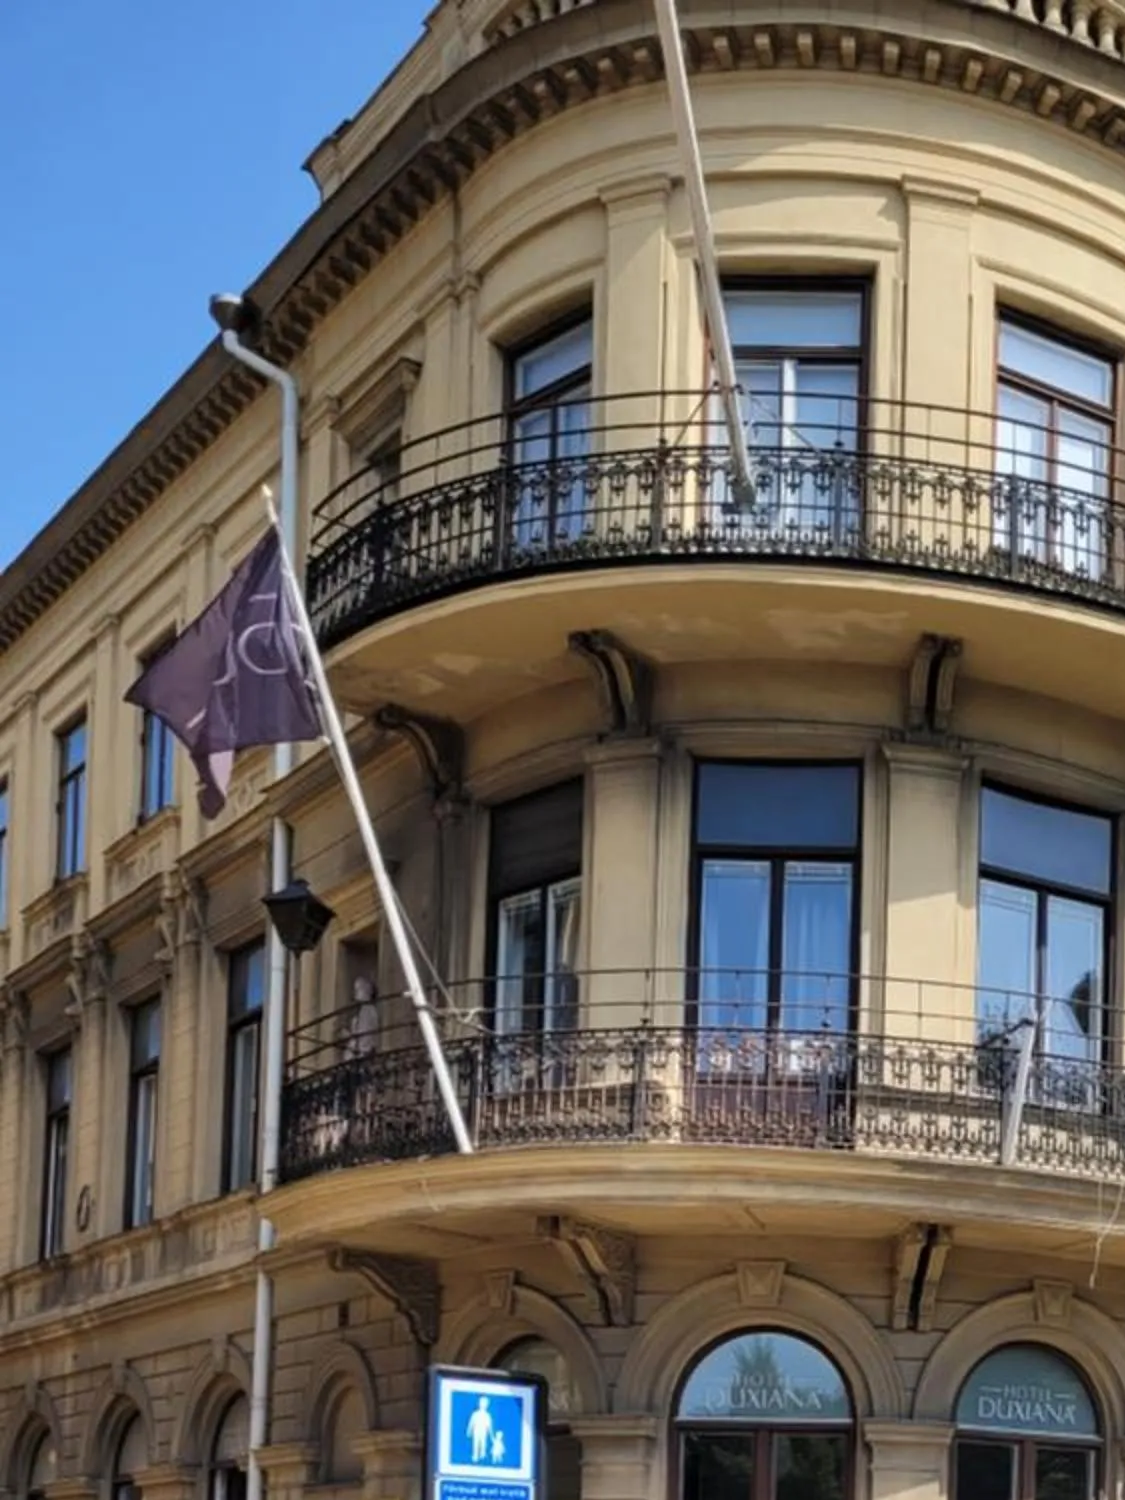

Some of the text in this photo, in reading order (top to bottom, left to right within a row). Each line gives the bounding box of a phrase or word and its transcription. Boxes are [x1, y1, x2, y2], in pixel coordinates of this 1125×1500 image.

[705, 1386, 822, 1410] DUXIANA
[1003, 1384, 1051, 1402] HOTEL
[978, 1396, 1076, 1425] DUXIANA
